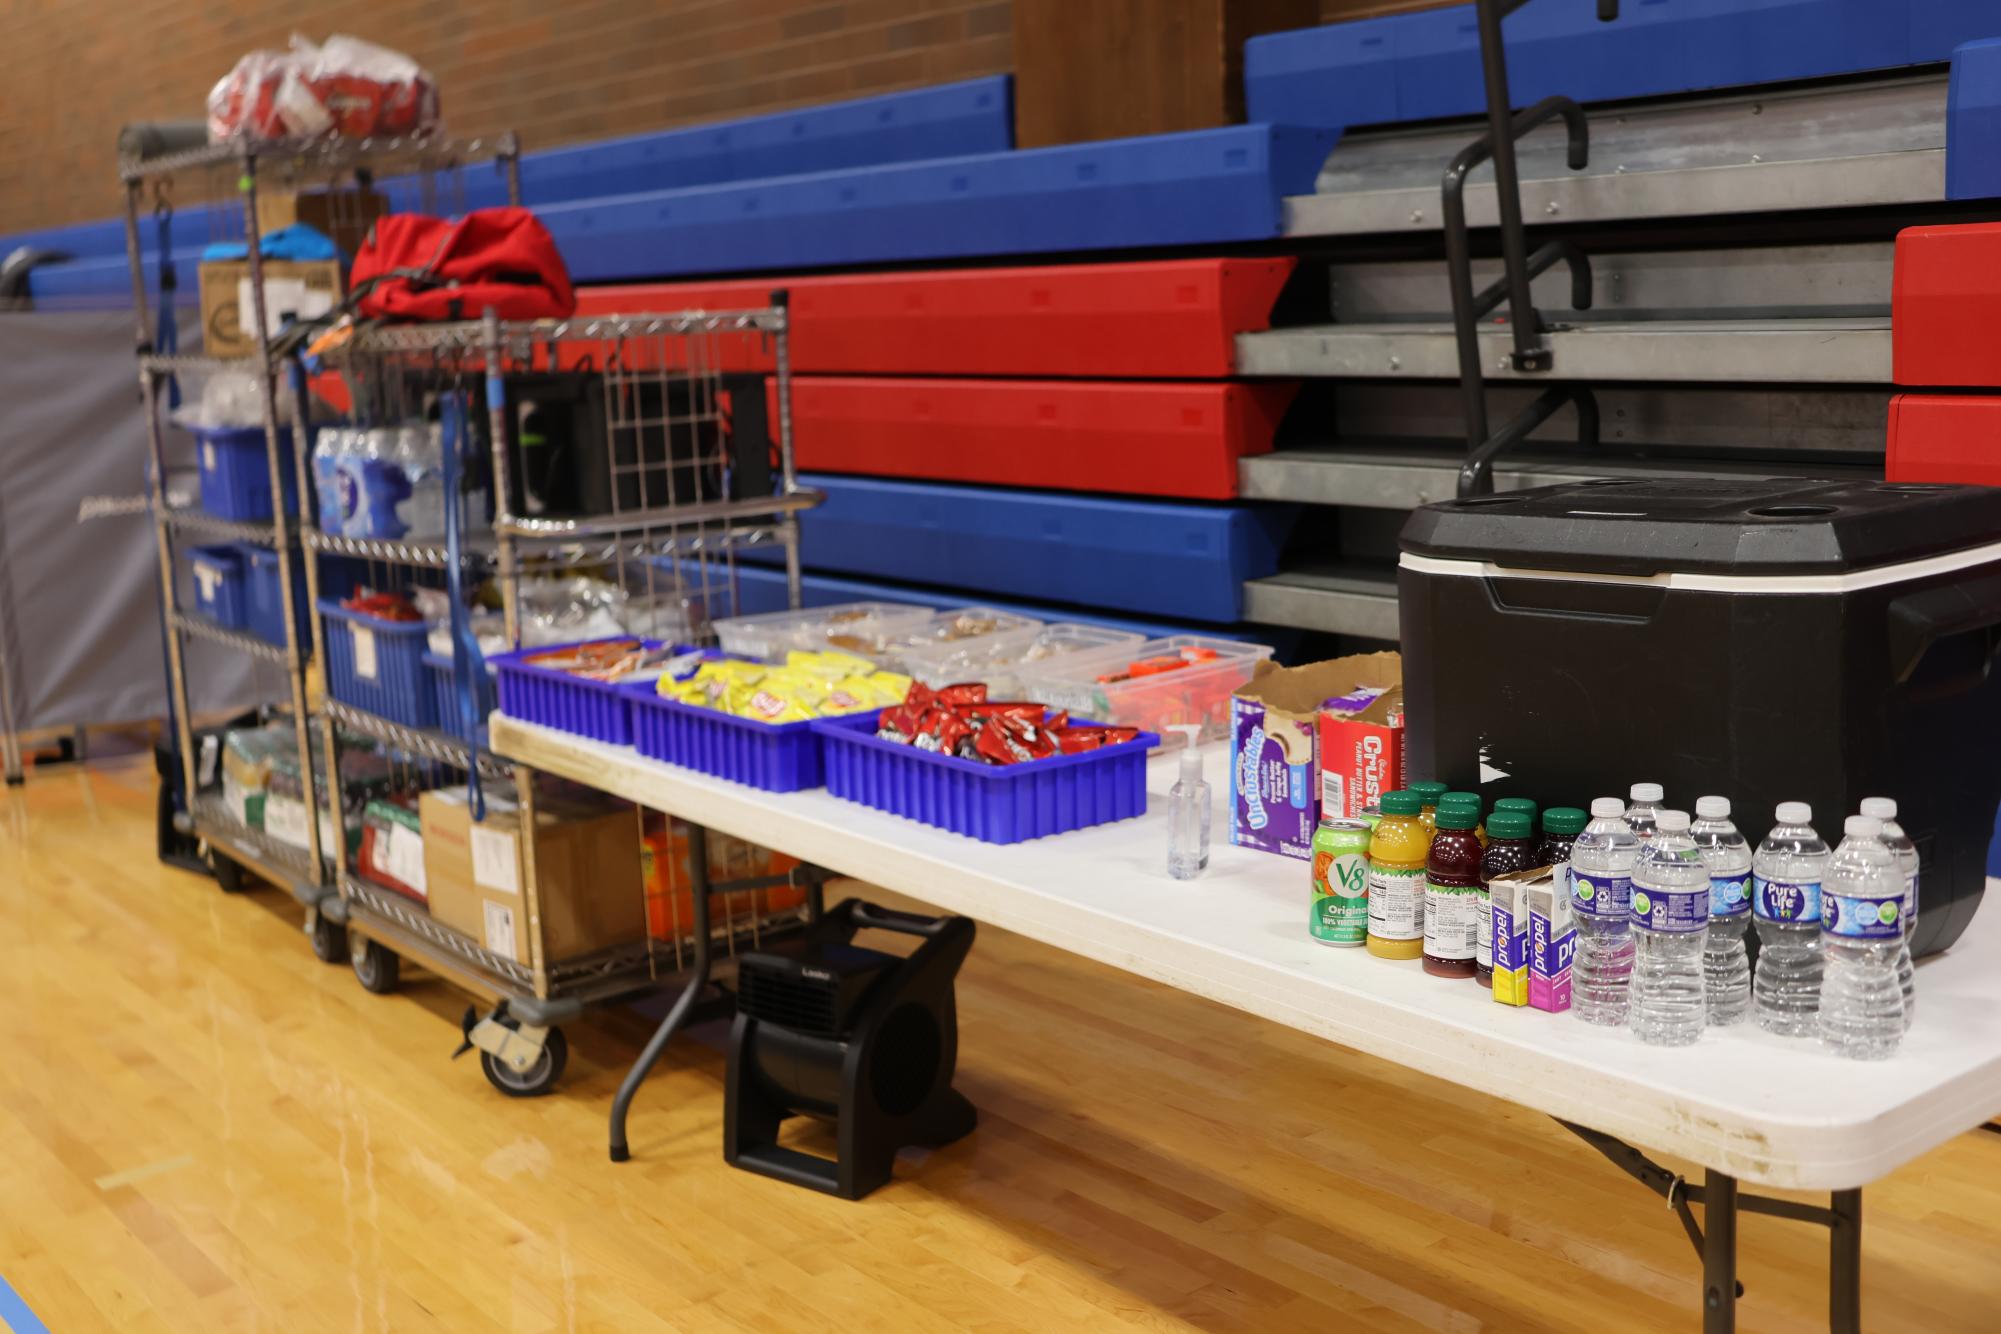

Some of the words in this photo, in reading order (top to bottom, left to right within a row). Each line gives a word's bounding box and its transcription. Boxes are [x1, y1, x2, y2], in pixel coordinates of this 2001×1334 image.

[1243, 724, 1267, 829] Uncrustables
[1335, 859, 1365, 892] V8
[1767, 883, 1798, 899] Pure
[1328, 904, 1368, 917] Origina
[1771, 895, 1794, 910] Life
[1494, 910, 1511, 967] propel
[1532, 915, 1548, 974] propel
[1558, 936, 1574, 969] pr
